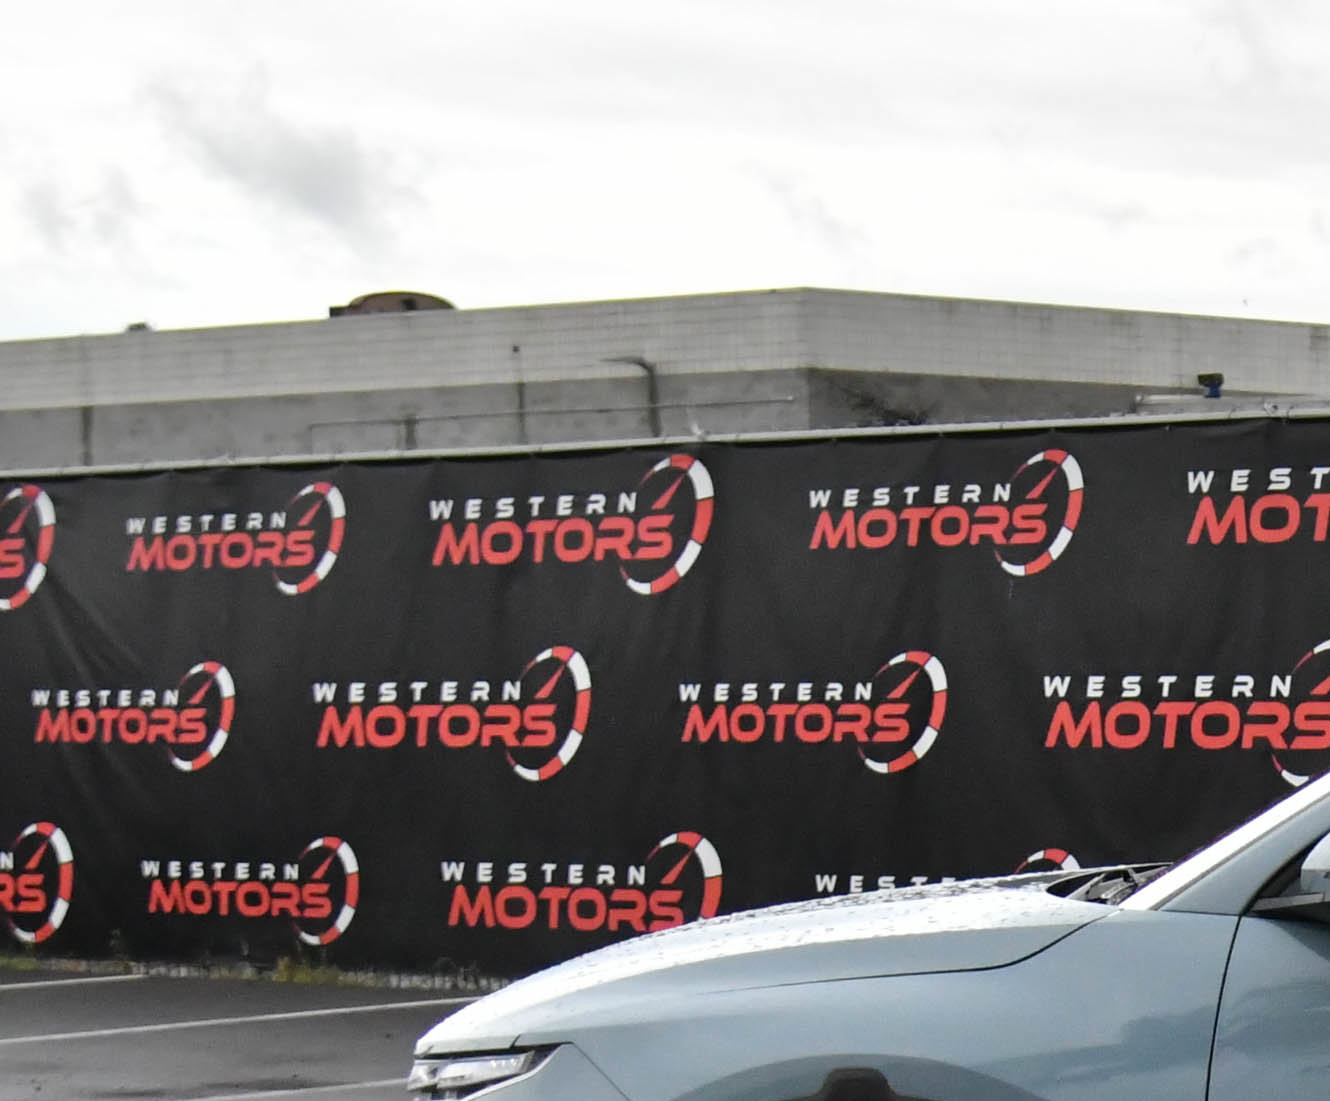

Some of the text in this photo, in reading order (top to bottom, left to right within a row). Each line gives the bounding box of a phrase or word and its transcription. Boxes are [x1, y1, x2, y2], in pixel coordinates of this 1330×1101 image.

[429, 491, 637, 521] WESTERN
[809, 482, 1012, 509] WESTERN
[125, 511, 287, 535] WESTERN
[810, 503, 1048, 550] MOTORS
[127, 529, 315, 571] MOTORS
[432, 514, 674, 567] MOTORS
[31, 689, 179, 708] WESTERN
[313, 680, 521, 703] WESTERN
[678, 682, 873, 702] WESTERN
[1043, 674, 1292, 698] WESTERN
[35, 707, 207, 745] MOTORS
[316, 703, 557, 749] MOTORS
[682, 702, 911, 743] MOTORS
[141, 860, 299, 880] WESTERN
[441, 861, 646, 886] WESTERN
[148, 879, 332, 919] MOTORS
[447, 884, 685, 932] MOTORS
